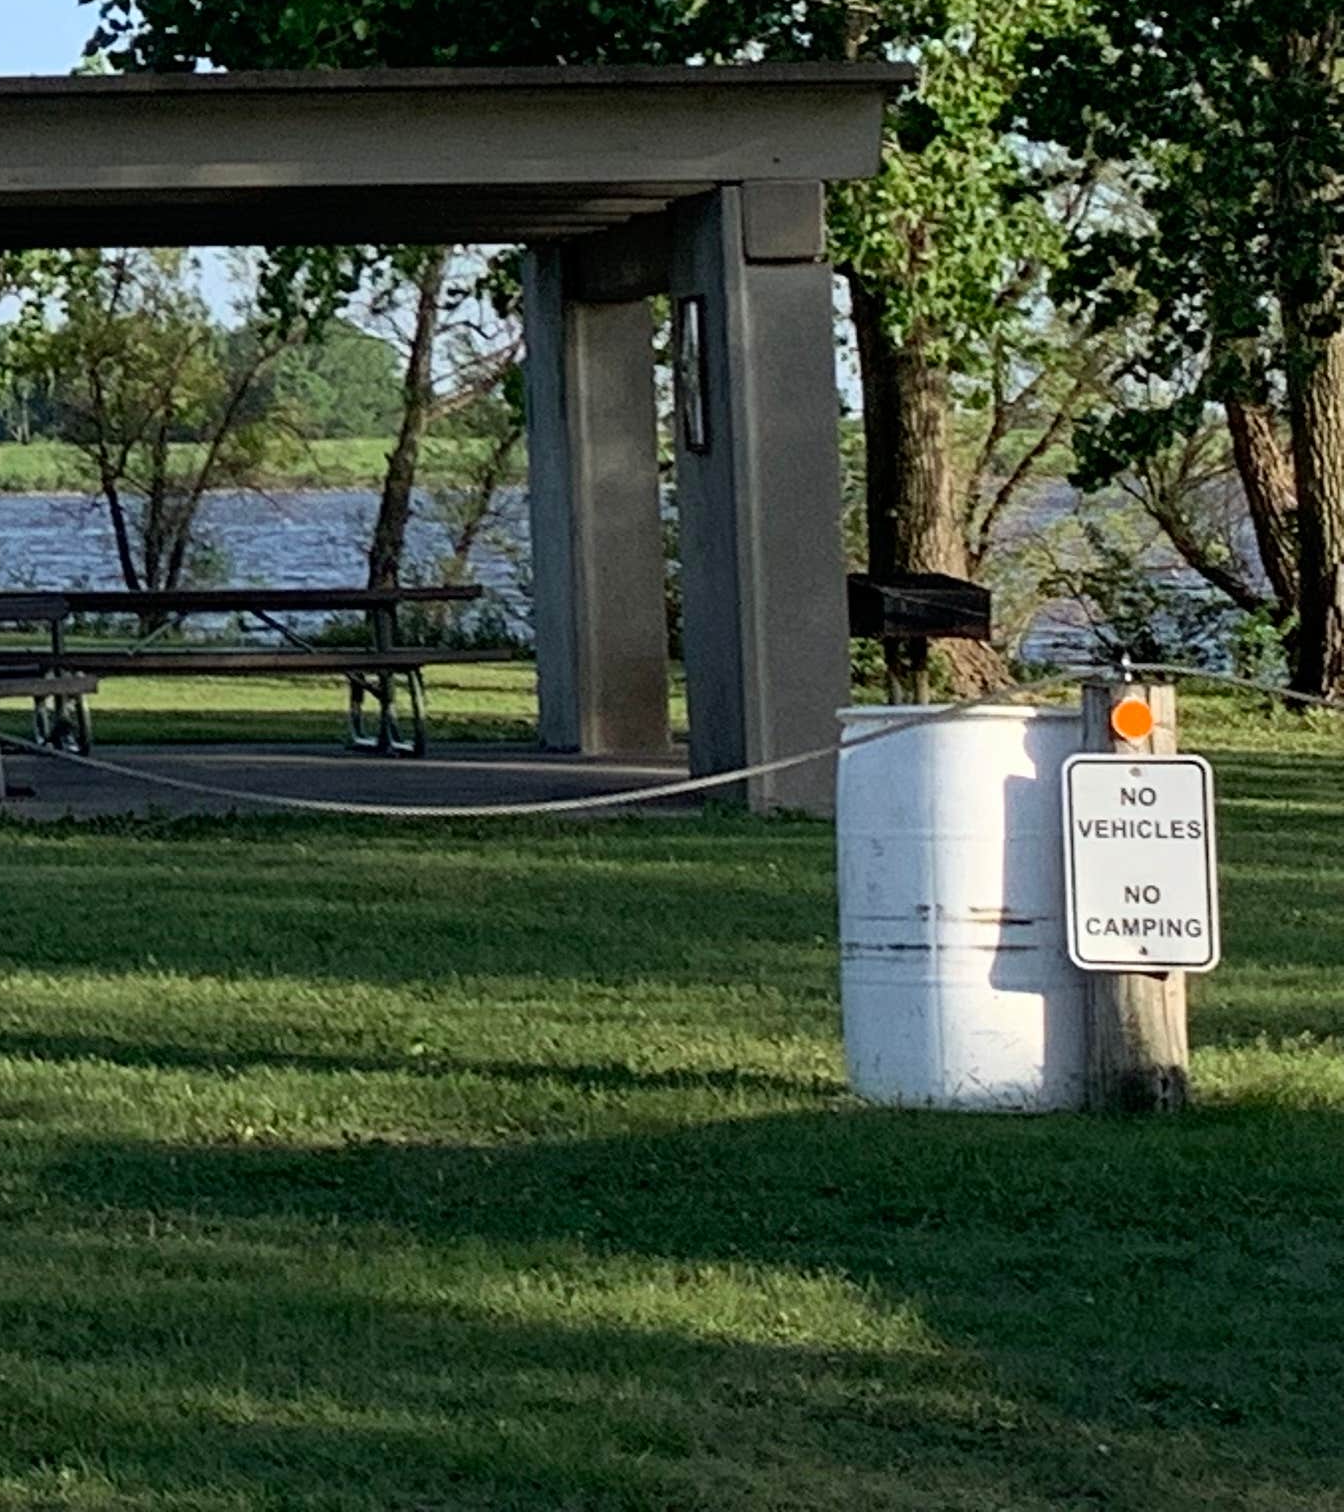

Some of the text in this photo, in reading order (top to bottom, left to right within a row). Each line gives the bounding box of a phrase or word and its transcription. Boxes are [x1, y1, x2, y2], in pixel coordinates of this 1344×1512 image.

[1120, 787, 1157, 807] NO
[1077, 819, 1202, 839] VEHICLES
[1124, 885, 1161, 904] NO
[1085, 917, 1202, 938] CAMPING
